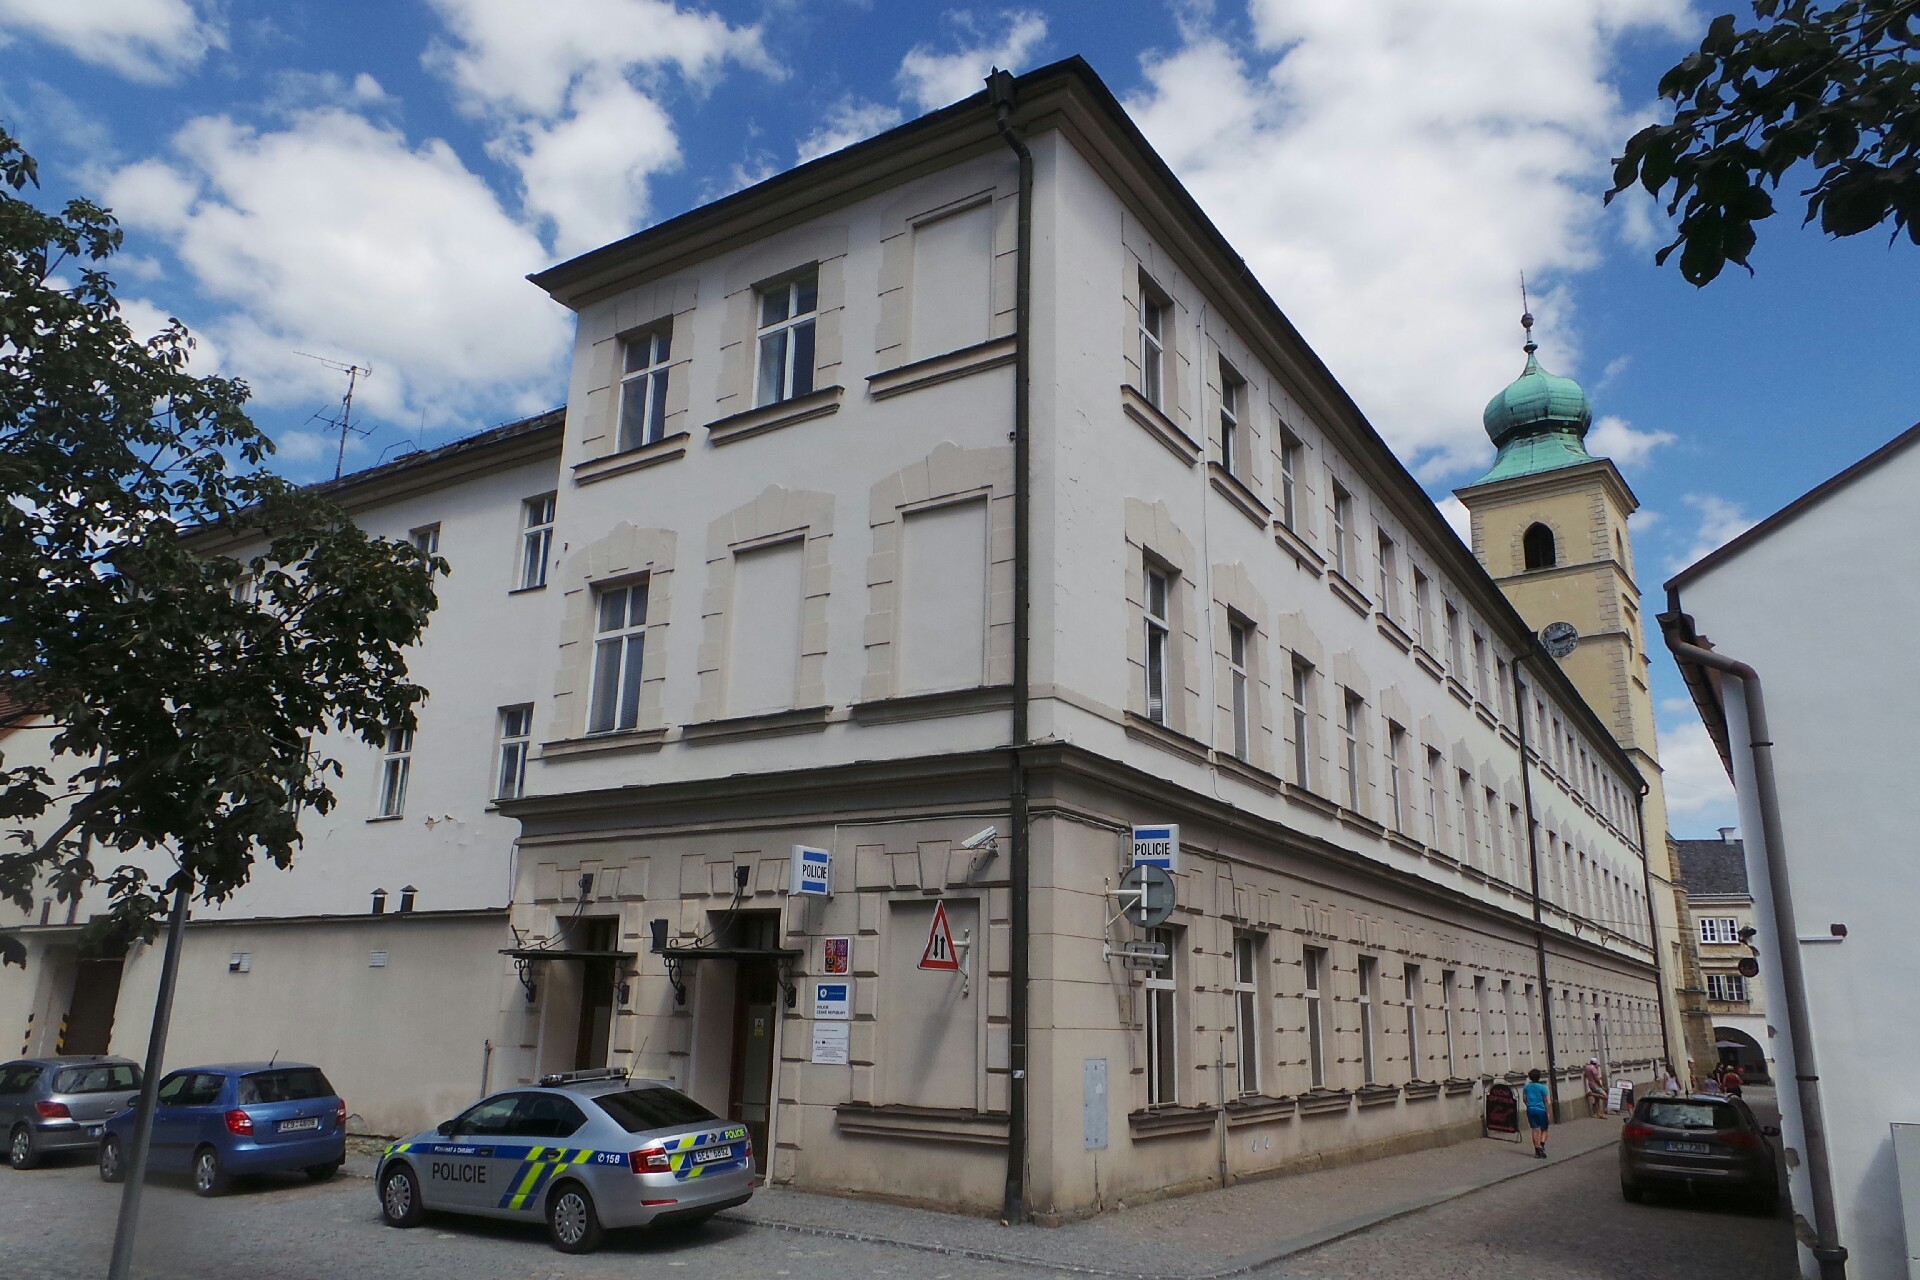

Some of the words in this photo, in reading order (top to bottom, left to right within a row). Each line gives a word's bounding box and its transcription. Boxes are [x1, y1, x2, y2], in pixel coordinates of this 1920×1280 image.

[1135, 842, 1170, 855] POLICIE
[802, 864, 827, 879] POLICIE
[725, 1128, 745, 1139] POLICIE
[606, 1154, 620, 1163] 158
[432, 1162, 486, 1183] POLICIE
